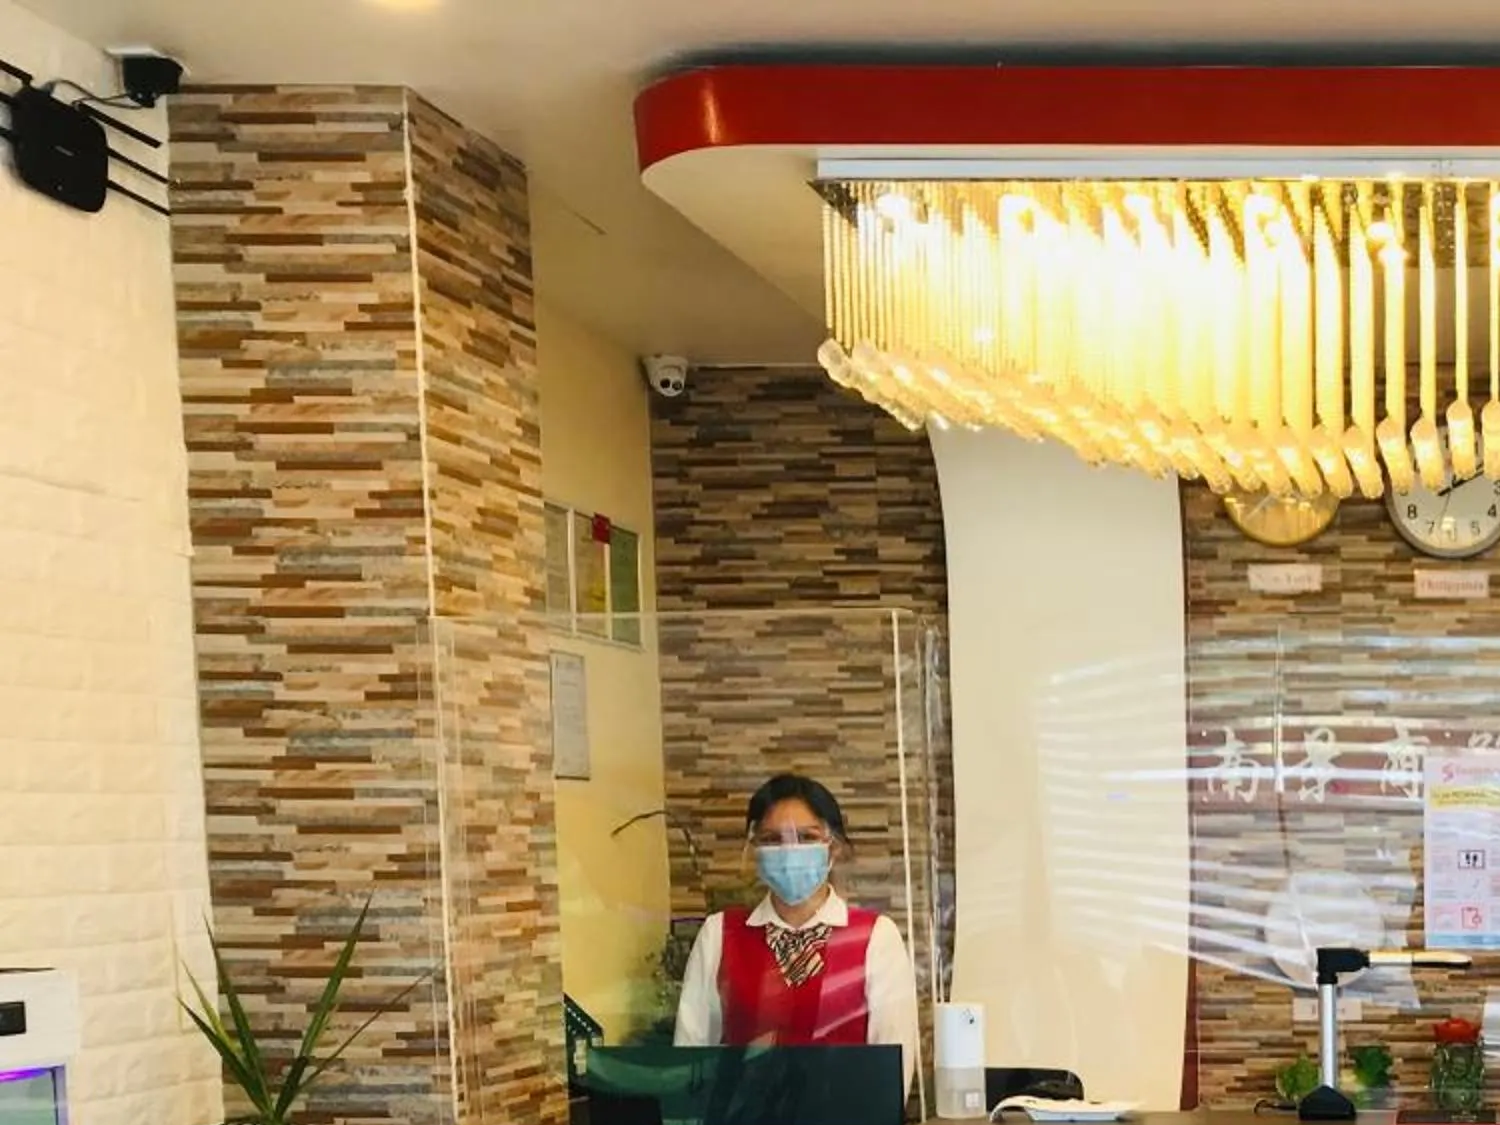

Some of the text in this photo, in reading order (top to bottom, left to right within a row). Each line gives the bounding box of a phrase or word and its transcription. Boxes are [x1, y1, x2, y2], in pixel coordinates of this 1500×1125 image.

[1407, 504, 1418, 519] 8
[1487, 503, 1498, 518] 4
[1426, 521, 1435, 535] 7
